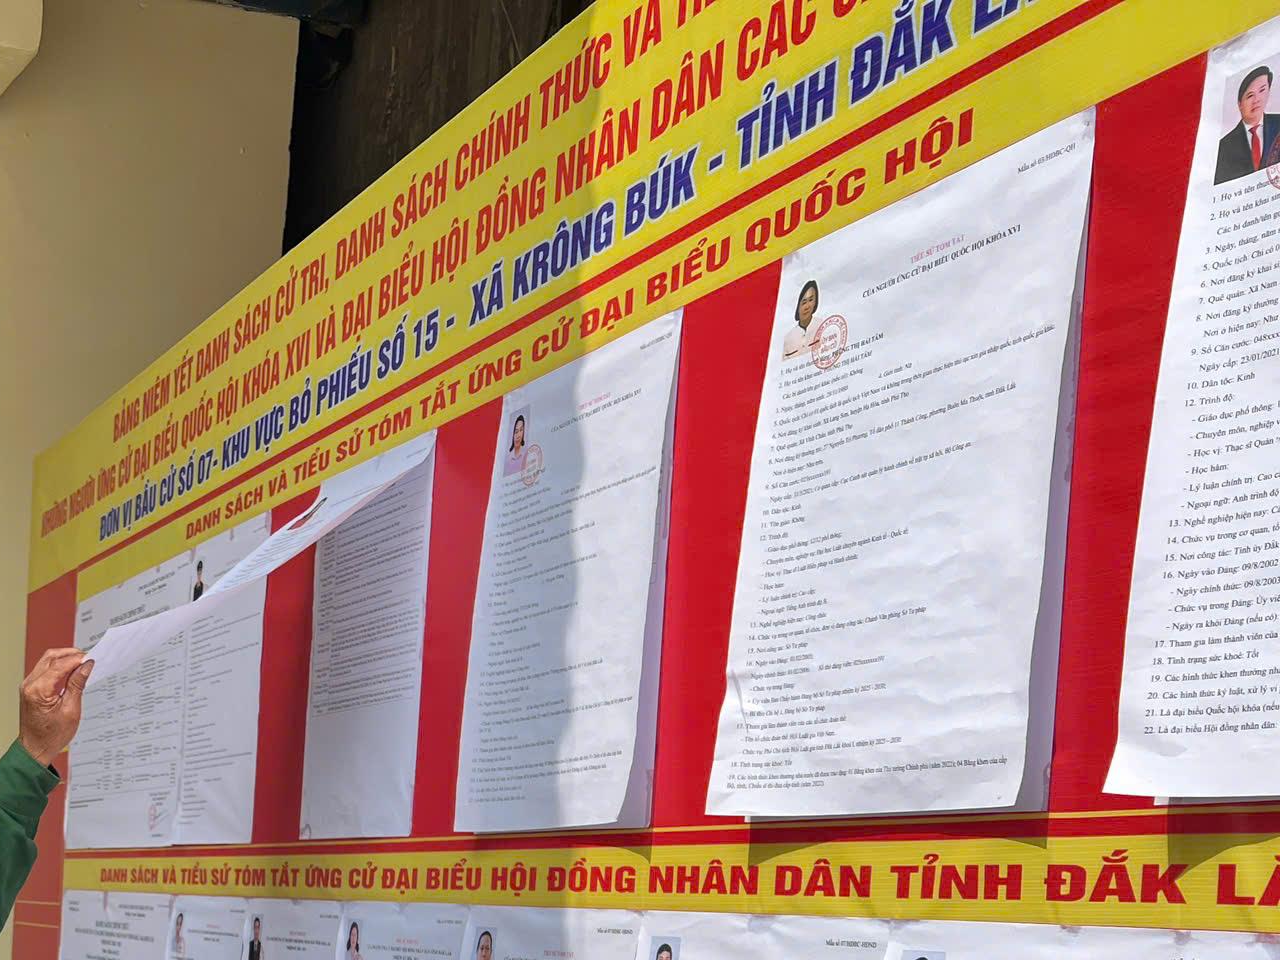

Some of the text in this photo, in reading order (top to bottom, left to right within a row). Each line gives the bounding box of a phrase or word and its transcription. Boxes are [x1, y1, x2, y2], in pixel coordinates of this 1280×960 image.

[99, 506, 120, 541] ĐƠN
[122, 499, 132, 530] VỊ
[134, 483, 156, 521] BẦU
[159, 464, 176, 506] CỬ
[177, 449, 195, 495] SỐ
[221, 425, 250, 470] KHU
[255, 405, 284, 452] VỰC
[288, 377, 311, 431] BỎ
[315, 345, 371, 415] PHIẾU
[377, 314, 406, 378] SỐ
[413, 309, 438, 357] 15
[469, 260, 503, 326] XÃ
[512, 202, 613, 301] KRÔNG
[624, 146, 697, 235] BÚK
[737, 60, 836, 168] TỈNH
[850, 0, 953, 104] ĐẮK
[151, 415, 180, 467] BIỂU
[181, 397, 214, 448] QUỐC
[215, 378, 240, 423] HỘI
[241, 351, 280, 404] KHÓA
[284, 329, 312, 379] XVI
[315, 311, 336, 358] VÀ
[341, 286, 373, 342] ĐẠI
[377, 251, 426, 317] BIỂU
[430, 218, 469, 284] HỘI
[475, 166, 547, 255] ĐỒNG
[554, 98, 641, 203] NHÂN
[649, 39, 726, 141] DÂN
[186, 106, 975, 538] DANH SÁCH VÀ TIỂU SỬ TÓM TẮT ỨNG CỬ ĐẠI BIỂU QUỐC HỘI
[194, 327, 232, 384] DANH
[230, 295, 272, 356] SÁCH
[273, 269, 300, 324] CỬ
[300, 252, 329, 304] TRI,
[334, 207, 386, 278] DANH
[390, 159, 448, 237] SÁCH
[454, 95, 531, 191] CHÍNH
[538, 31, 613, 128] THỨC
[1237, 372, 1255, 382] Kinh
[100, 867, 128, 883] DANH
[128, 866, 159, 884] SÁCH
[161, 865, 177, 885] VÀ
[179, 864, 207, 885] TIỂU
[209, 863, 231, 886] SỬ
[234, 866, 266, 886] TÓM
[271, 864, 299, 886] TẮT
[306, 868, 342, 887] ỨNG
[348, 864, 377, 889] CỬ
[380, 867, 417, 890] ĐẠI
[425, 859, 481, 891] BIỂU
[490, 862, 536, 896] HỘI
[546, 857, 636, 895] ĐỒNG
[647, 858, 758, 896] NHÂN
[773, 857, 871, 899] DÂN
[889, 852, 1023, 901] TỈNH
[1043, 849, 1186, 904] ĐẮK
